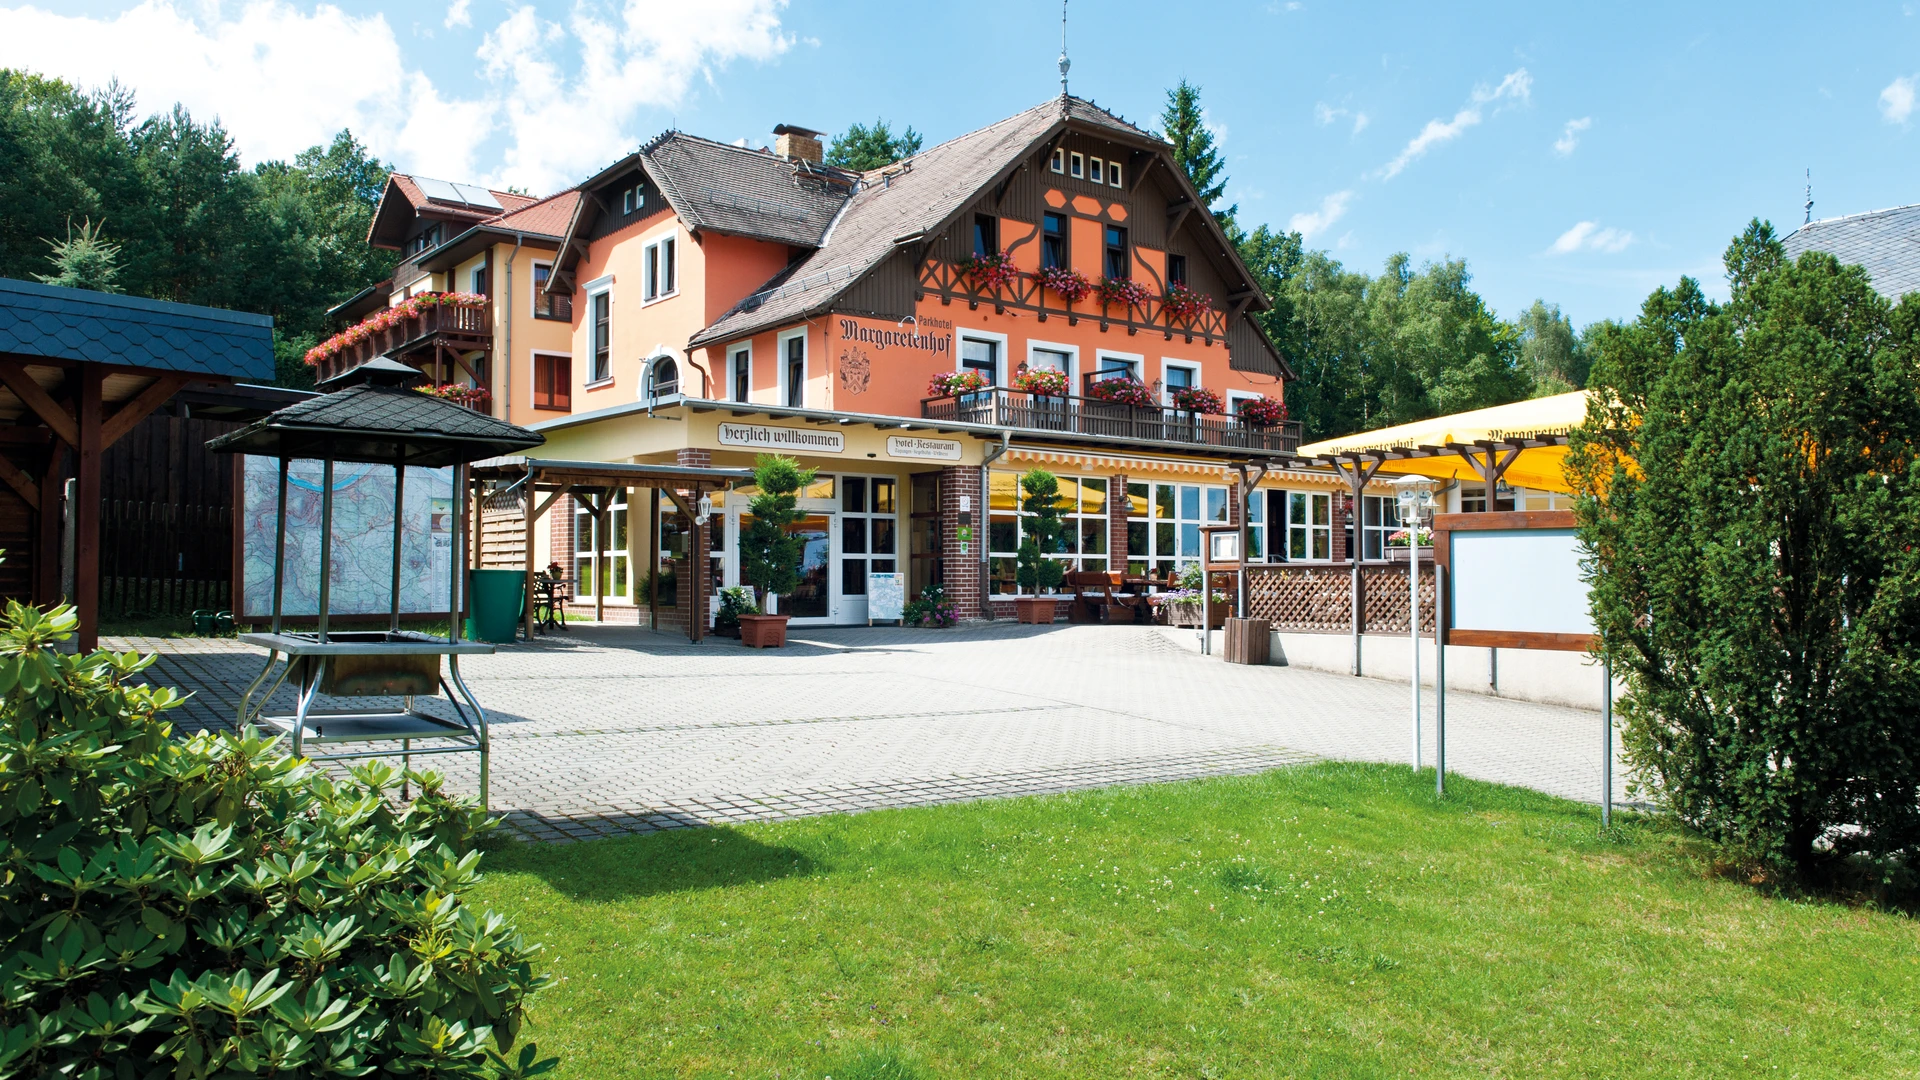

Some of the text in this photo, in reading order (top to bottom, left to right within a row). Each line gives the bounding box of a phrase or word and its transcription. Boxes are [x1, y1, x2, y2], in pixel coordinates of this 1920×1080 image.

[919, 315, 952, 329] Parkhotel
[840, 319, 952, 359] Margaretenhof
[724, 425, 839, 447] Herzlich willkommen
